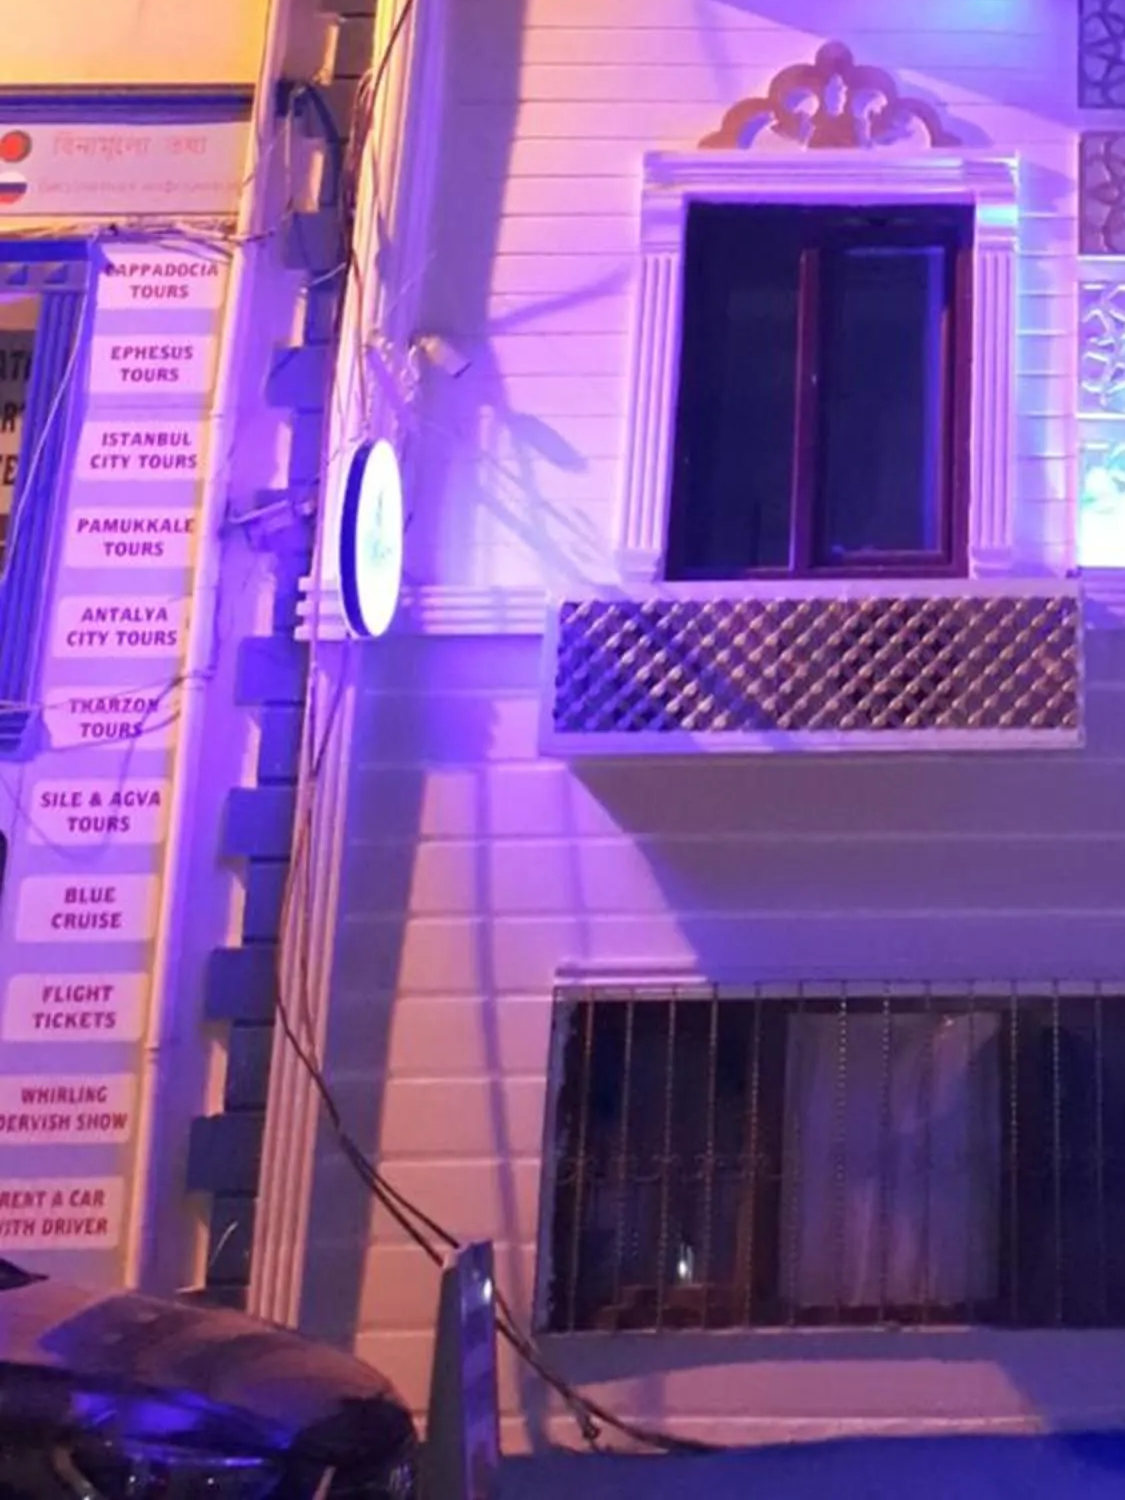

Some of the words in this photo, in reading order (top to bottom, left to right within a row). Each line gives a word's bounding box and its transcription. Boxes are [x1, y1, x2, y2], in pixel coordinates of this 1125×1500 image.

[105, 262, 219, 277] CAPPADOCIA
[130, 284, 189, 299] TOURS
[110, 345, 194, 360] EPHESUS
[120, 367, 180, 382] TOURS
[101, 432, 192, 447] ISTANBUL
[90, 454, 131, 469] CITY
[138, 454, 198, 469] TOURS
[76, 517, 195, 533] PAMUKKALE
[104, 541, 165, 557] TOURS
[80, 606, 169, 622] ANTALYA
[66, 630, 109, 647] CITY
[116, 630, 178, 646] TOURS
[80, 721, 143, 739] TOURS
[40, 791, 82, 808] SILE
[89, 791, 101, 807] &
[67, 816, 131, 833] TOURS
[64, 886, 117, 904] BLUE
[51, 912, 123, 930] CRUISE
[41, 984, 115, 1002] FLIGHT
[33, 1011, 117, 1030] TICKETS
[22, 1085, 107, 1104] WHIRLING
[77, 1112, 128, 1131] SHOW
[51, 1189, 64, 1207] A
[69, 1189, 105, 1207] CAR
[0, 1219, 36, 1236] ITH
[41, 1217, 107, 1236] DRIVER
